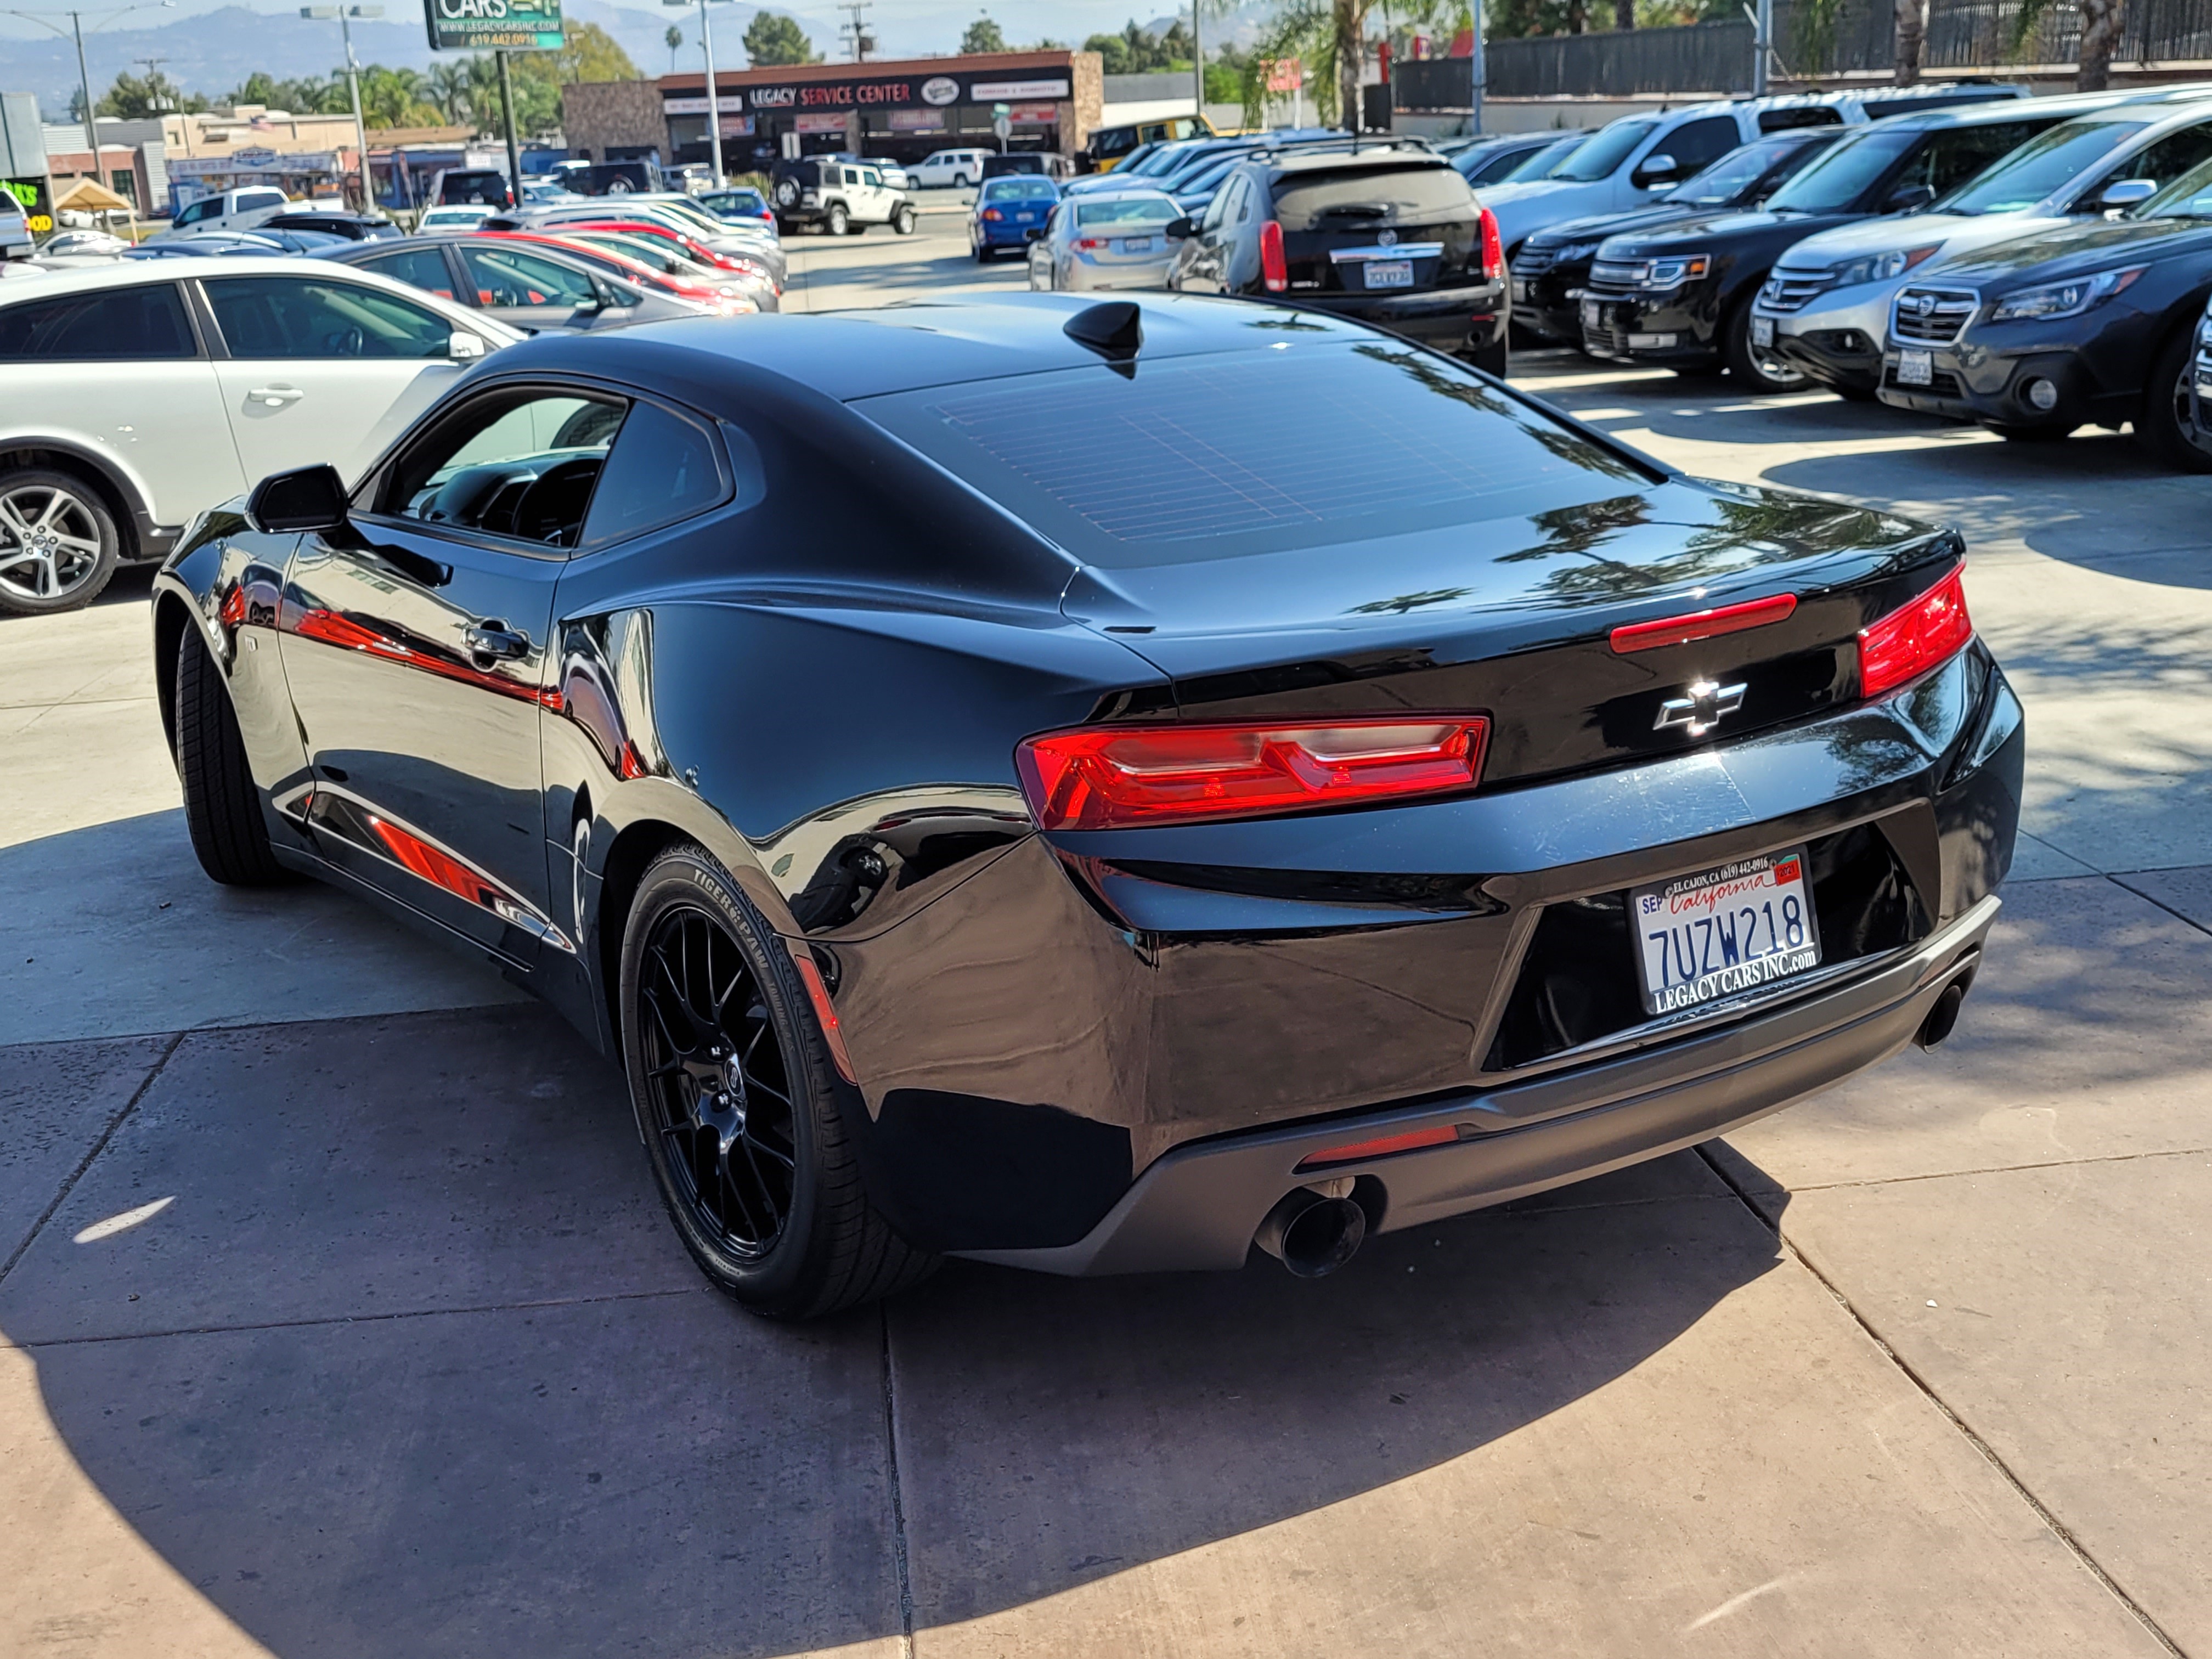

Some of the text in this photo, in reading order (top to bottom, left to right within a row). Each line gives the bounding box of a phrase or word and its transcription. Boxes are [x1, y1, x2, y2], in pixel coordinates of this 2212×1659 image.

[749, 87, 796, 105] LEGACY
[799, 86, 853, 106] SERVICE
[856, 83, 910, 103] CENTER
[1670, 874, 1778, 915] California
[1673, 882, 1683, 893] EL
[1709, 871, 1720, 884] CA
[1720, 864, 1739, 882] (619)
[1739, 856, 1768, 874] 442-0916
[695, 868, 769, 969] TIGER PAW
[1643, 896, 1663, 915] SEP
[1649, 895, 1804, 988] 7UZW218
[1654, 950, 1816, 1014] LEGACY CARS INC.com
